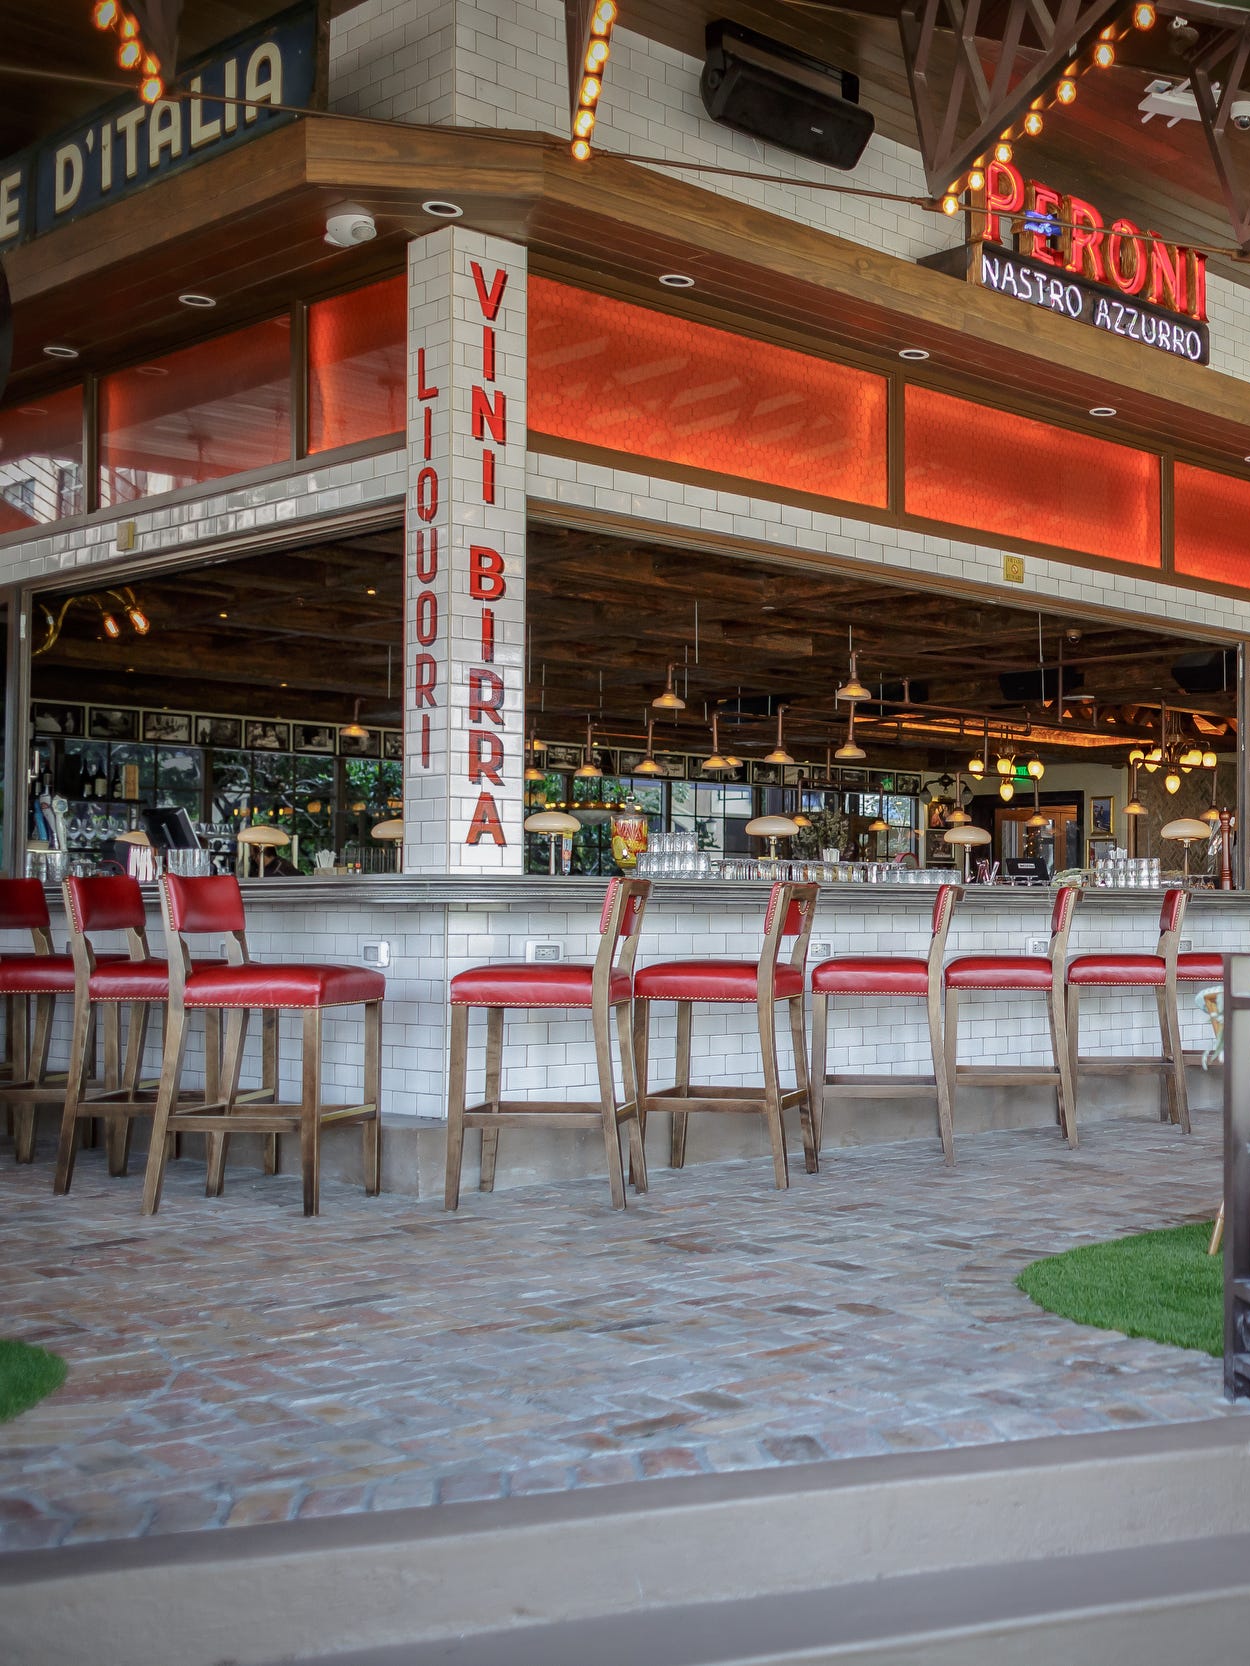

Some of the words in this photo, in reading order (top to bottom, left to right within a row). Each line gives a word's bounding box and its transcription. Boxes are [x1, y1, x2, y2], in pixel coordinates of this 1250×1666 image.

[55, 41, 283, 215] D'ITALIA
[980, 253, 1083, 318] NASTRO
[1094, 298, 1202, 361] AZZURRO
[982, 160, 1210, 323] PERONI
[470, 260, 509, 505] VINI
[415, 347, 440, 769] LIQUORI
[466, 544, 508, 848] BIRRA
